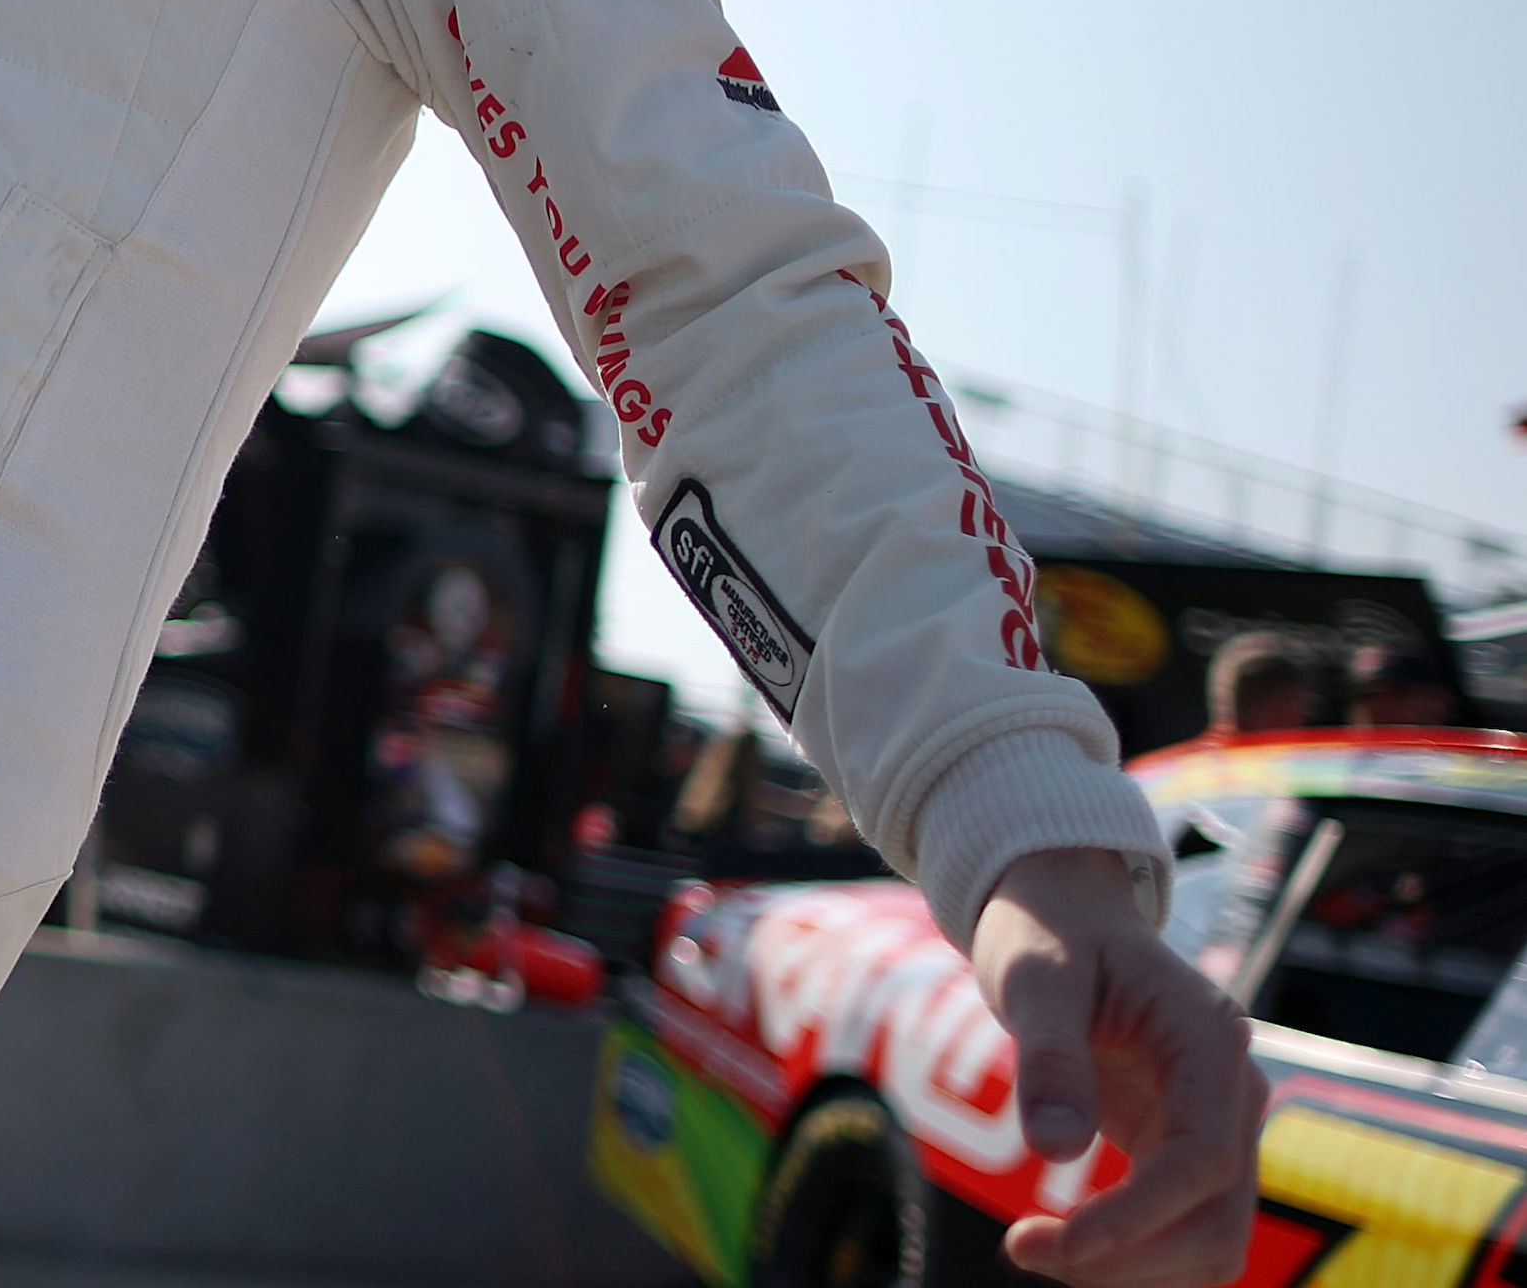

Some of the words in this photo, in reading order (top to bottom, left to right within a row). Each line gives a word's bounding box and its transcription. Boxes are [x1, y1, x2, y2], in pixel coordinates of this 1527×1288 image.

[676, 529, 715, 590] sfi
[720, 579, 789, 668] MANUFACTURER
[728, 604, 772, 664] CERTIFIED
